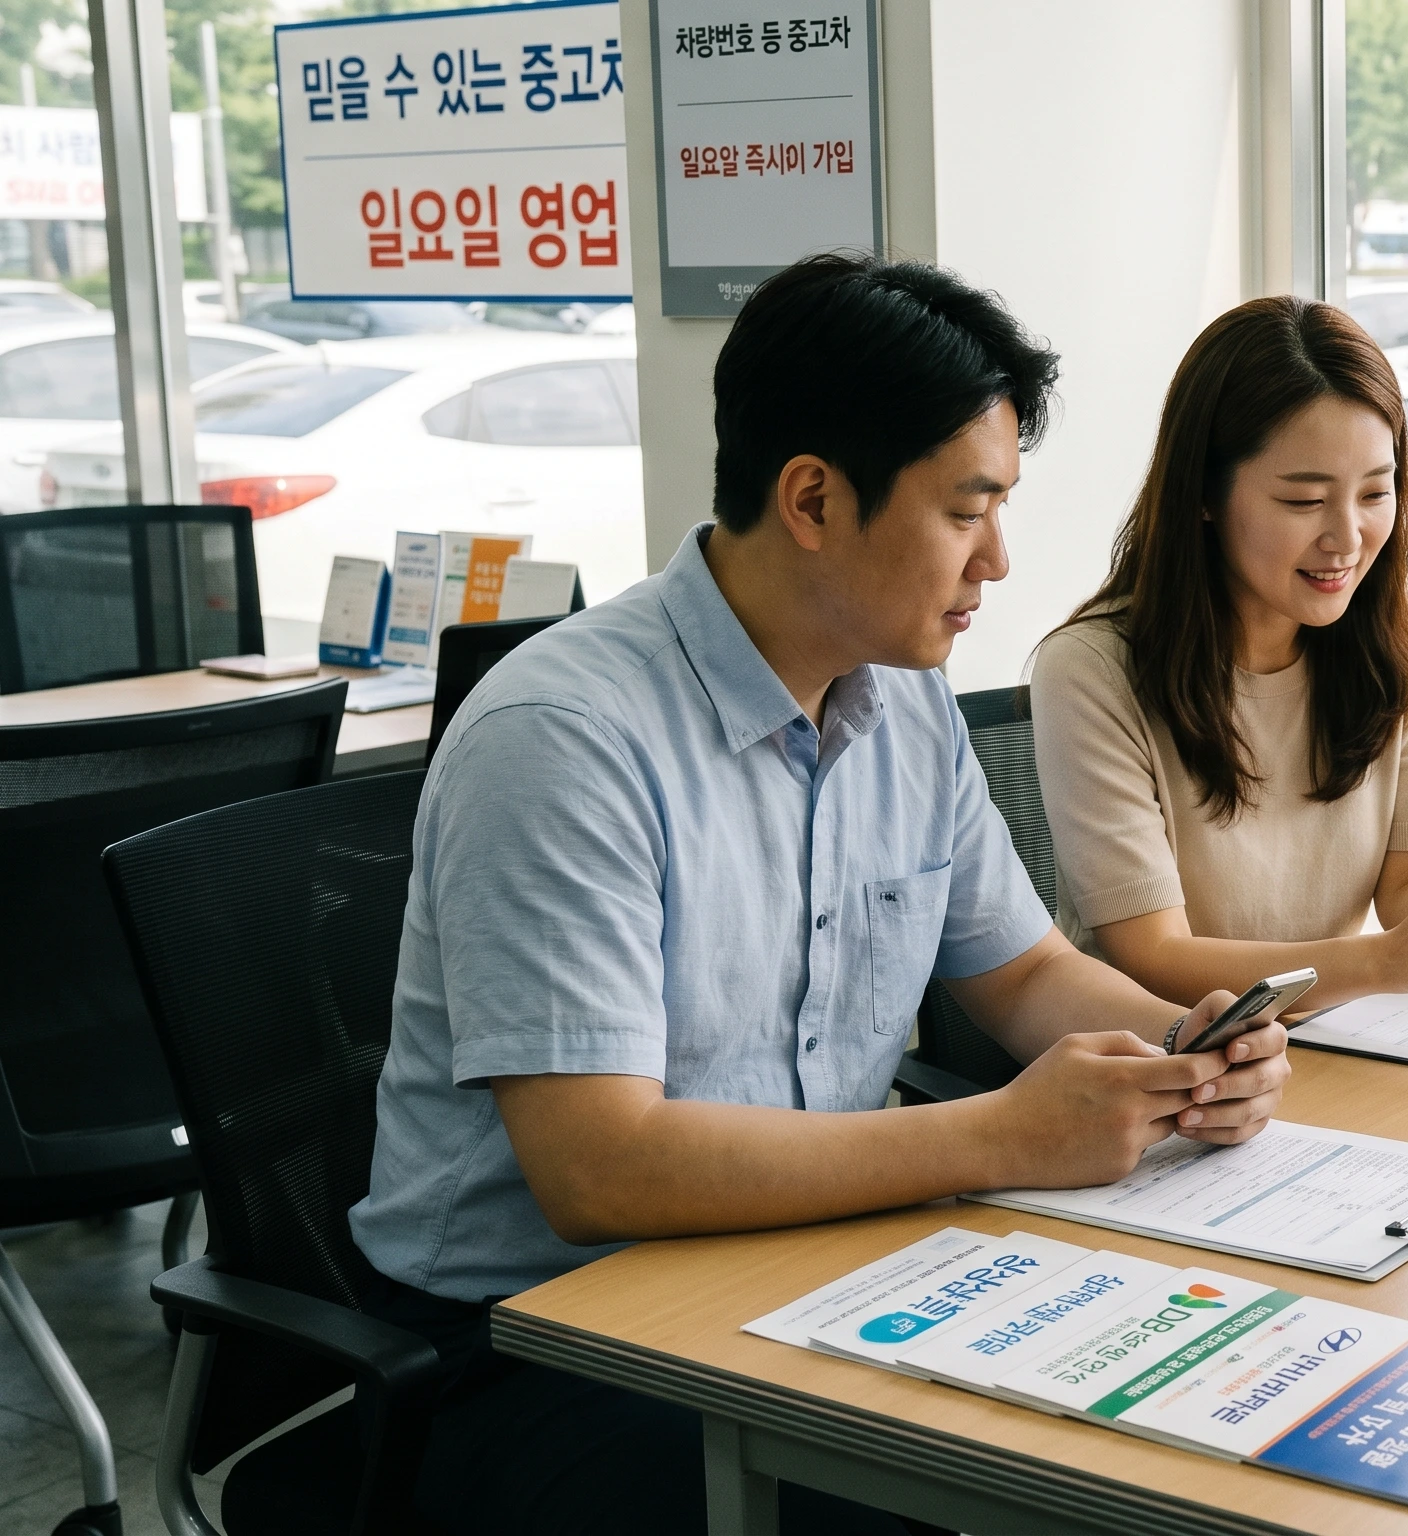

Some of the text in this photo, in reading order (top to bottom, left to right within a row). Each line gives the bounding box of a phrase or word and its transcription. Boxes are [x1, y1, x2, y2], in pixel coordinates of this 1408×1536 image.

[675, 15, 851, 59] 차량번호 등 중고차
[302, 56, 369, 121] 믿을
[384, 53, 418, 119] 수
[433, 49, 506, 114] 있는
[813, 140, 854, 174] 가입
[361, 180, 618, 269] 일요일 영업
